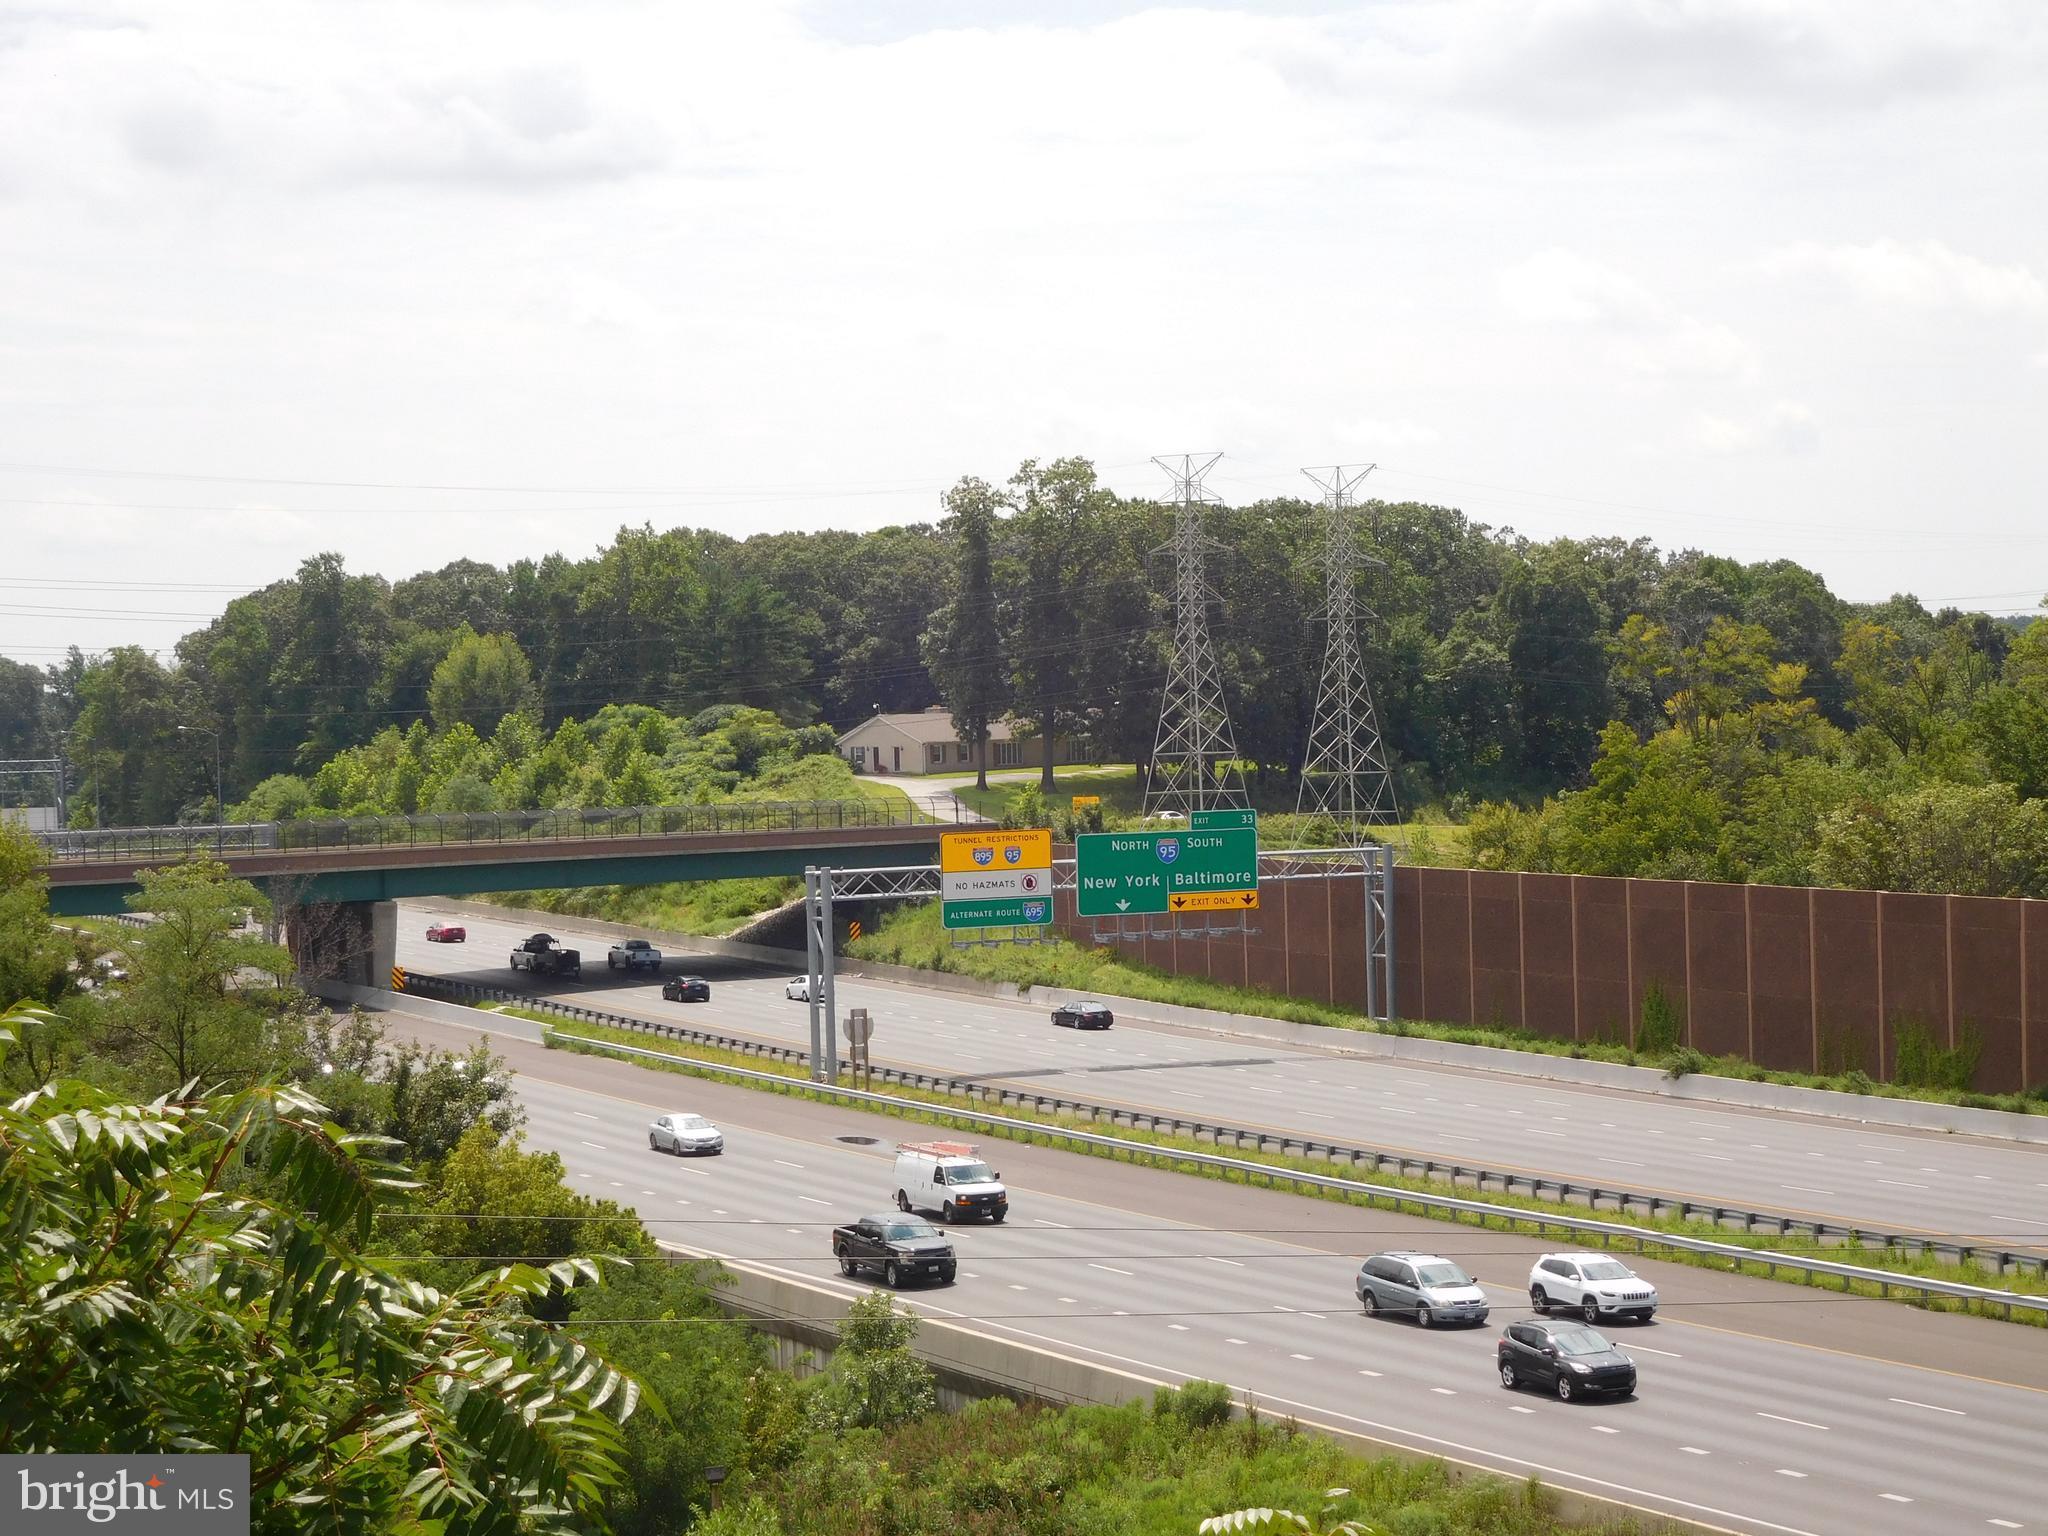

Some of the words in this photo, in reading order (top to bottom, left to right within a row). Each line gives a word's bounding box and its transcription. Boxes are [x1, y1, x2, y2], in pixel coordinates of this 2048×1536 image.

[1241, 814, 1253, 824] 33
[986, 834, 1039, 843] RESTRICTIONS
[1187, 837, 1223, 848] SOUTH
[1111, 840, 1149, 851] NORTH
[974, 851, 992, 862] 895
[1006, 850, 1019, 860] 95
[1159, 846, 1176, 858] 95
[1084, 877, 1117, 889] New
[1125, 873, 1160, 887] York
[1175, 871, 1251, 885] Baltimore
[955, 882, 968, 890] NO
[972, 880, 1016, 889] HAZMATS
[1191, 898, 1209, 906] EXIT
[1213, 896, 1236, 905] ONLY
[950, 910, 992, 919] ALTERNATE
[996, 908, 1020, 917] ROUTE
[1025, 907, 1043, 917] 695
